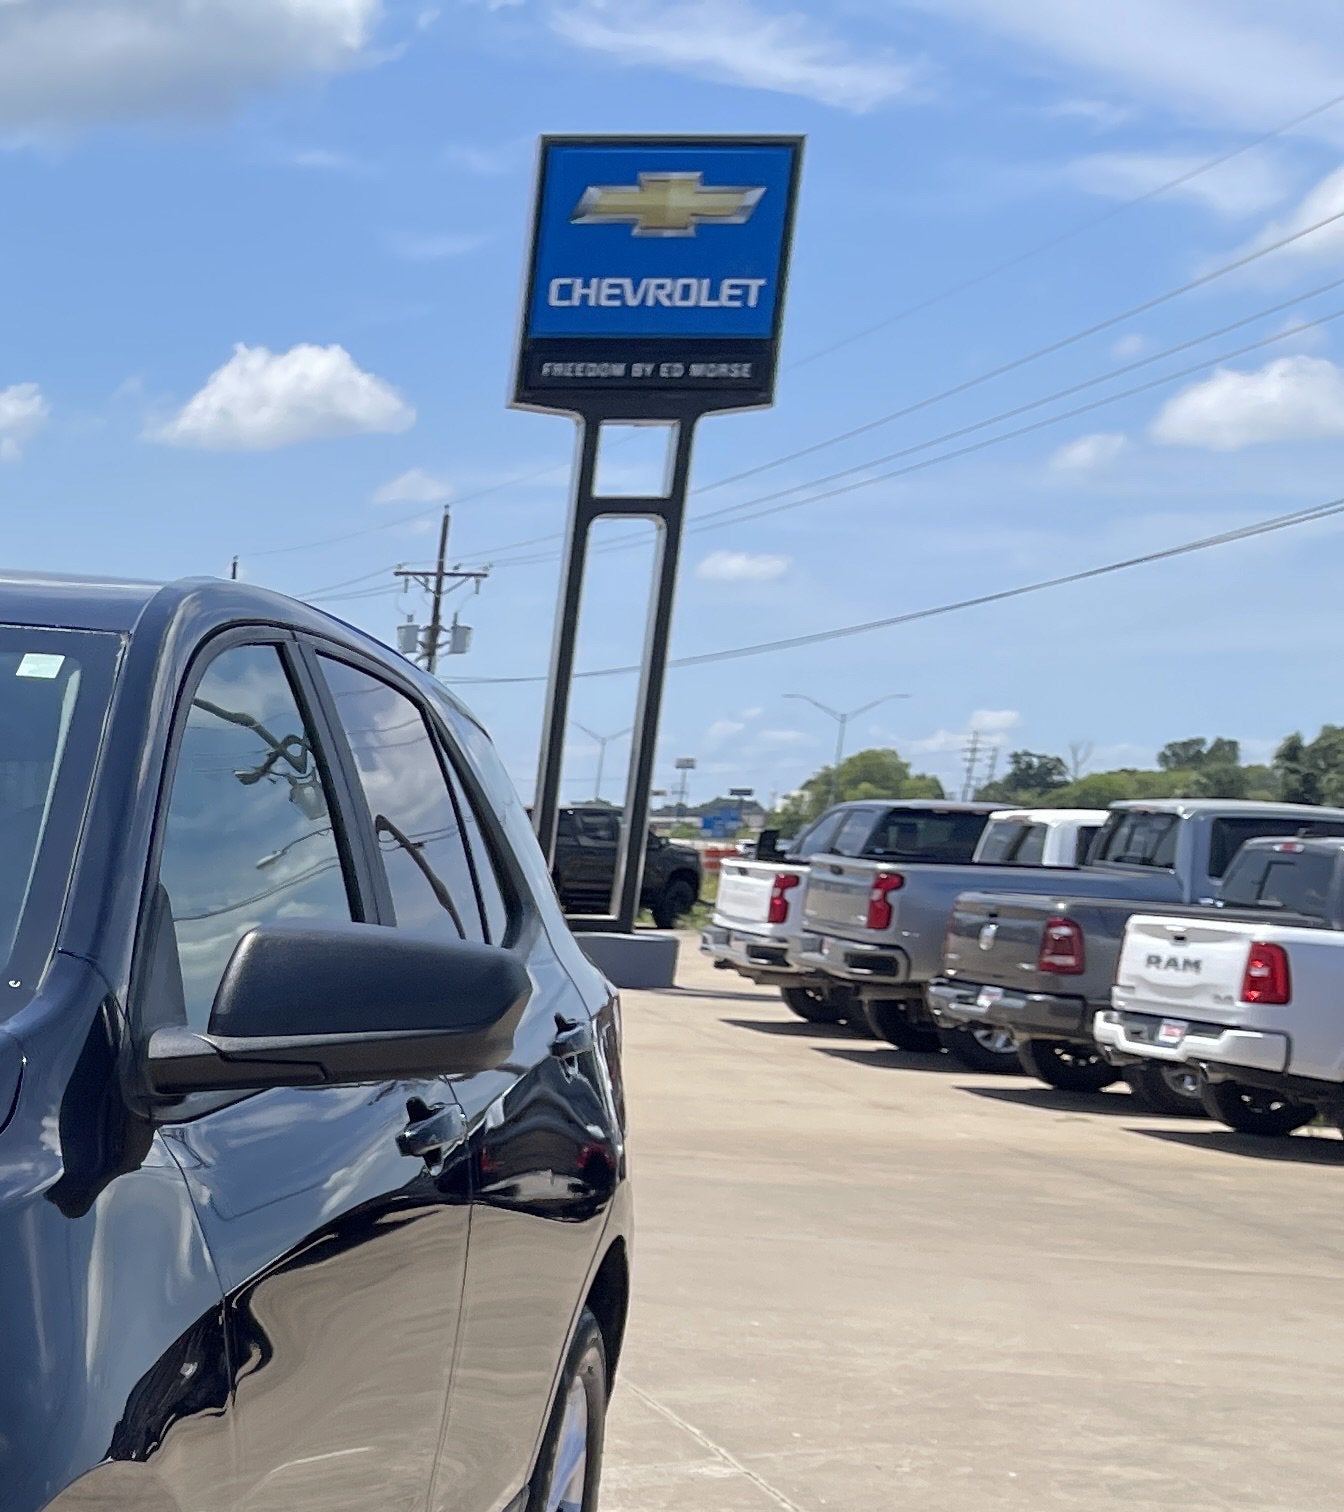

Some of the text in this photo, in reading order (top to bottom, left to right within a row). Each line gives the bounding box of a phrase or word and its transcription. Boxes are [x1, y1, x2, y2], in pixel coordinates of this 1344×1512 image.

[548, 278, 767, 307] CHEVROLET
[541, 362, 752, 378] FREEDOM BY ED MORSE
[1146, 954, 1203, 975] RAM
